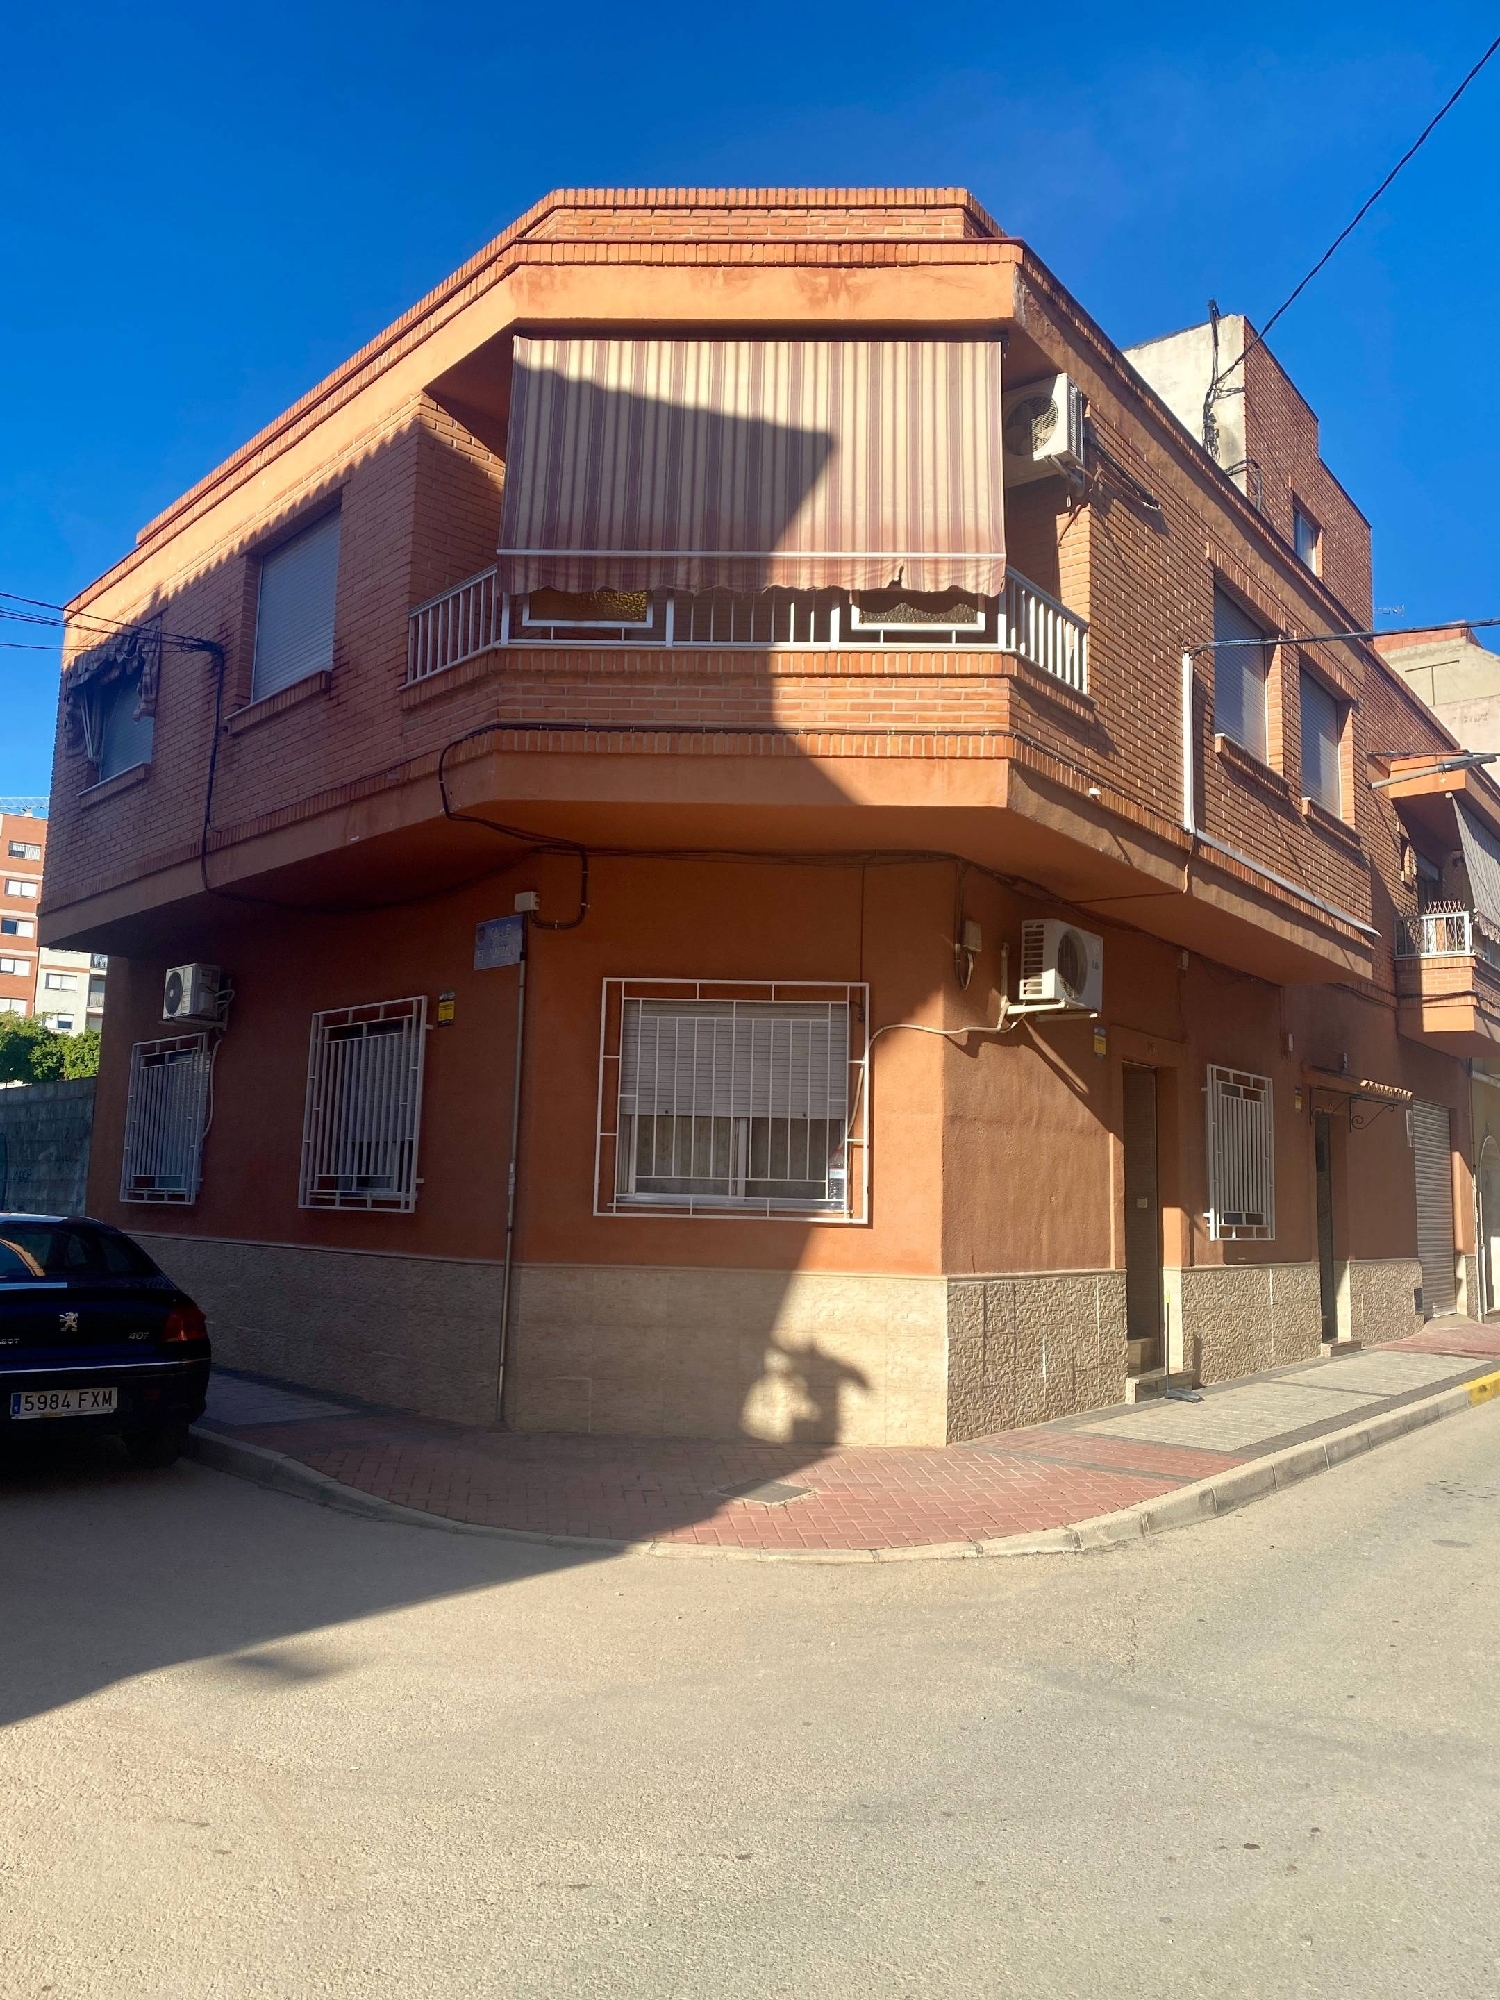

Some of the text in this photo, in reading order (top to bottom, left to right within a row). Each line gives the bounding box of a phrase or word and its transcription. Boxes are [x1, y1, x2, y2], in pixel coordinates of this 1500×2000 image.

[128, 1331, 150, 1340] 407
[24, 1390, 112, 1411] 5984 FXM
